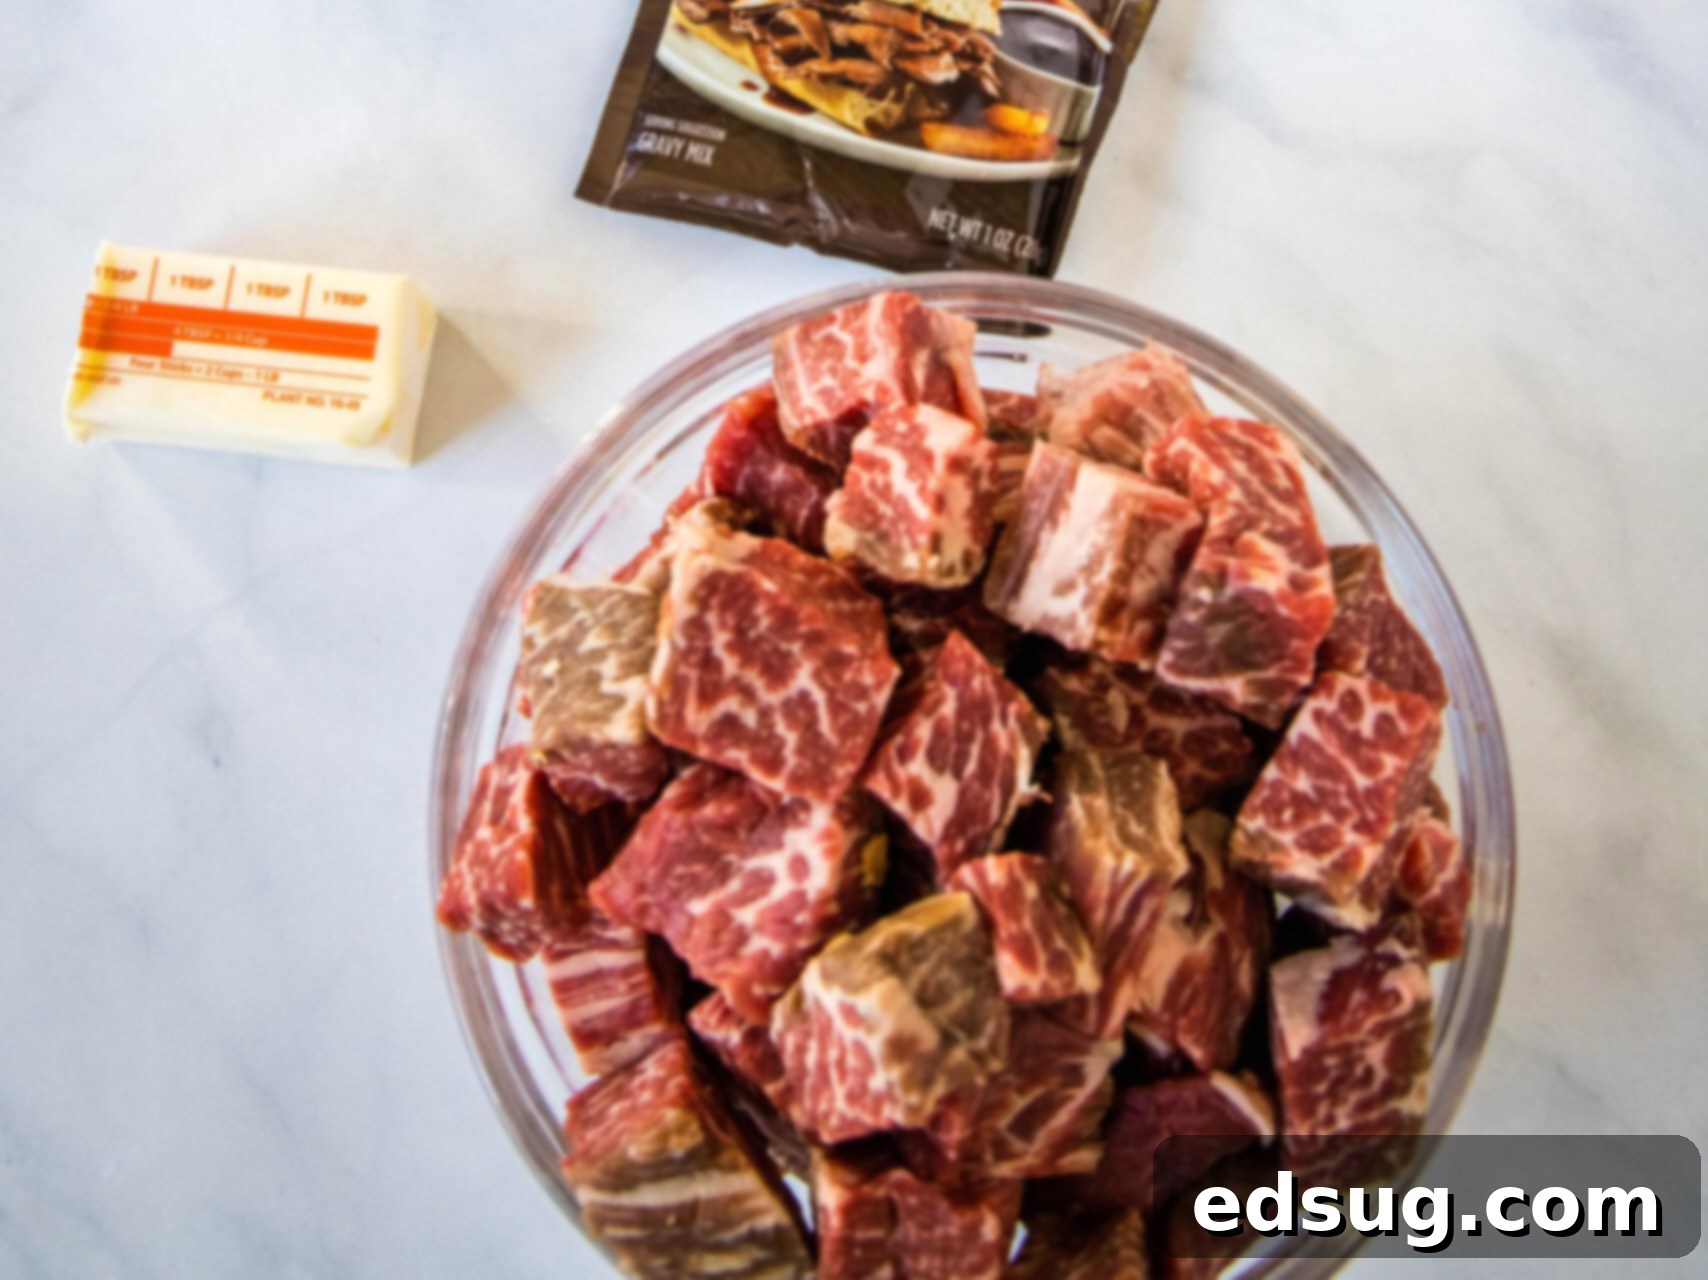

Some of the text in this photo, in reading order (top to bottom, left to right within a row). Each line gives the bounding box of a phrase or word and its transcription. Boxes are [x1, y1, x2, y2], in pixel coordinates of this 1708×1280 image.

[180, 274, 215, 291] TBSP
[256, 284, 291, 300] TBSP
[333, 292, 368, 308] TBSP
[262, 389, 303, 406] PLANT
